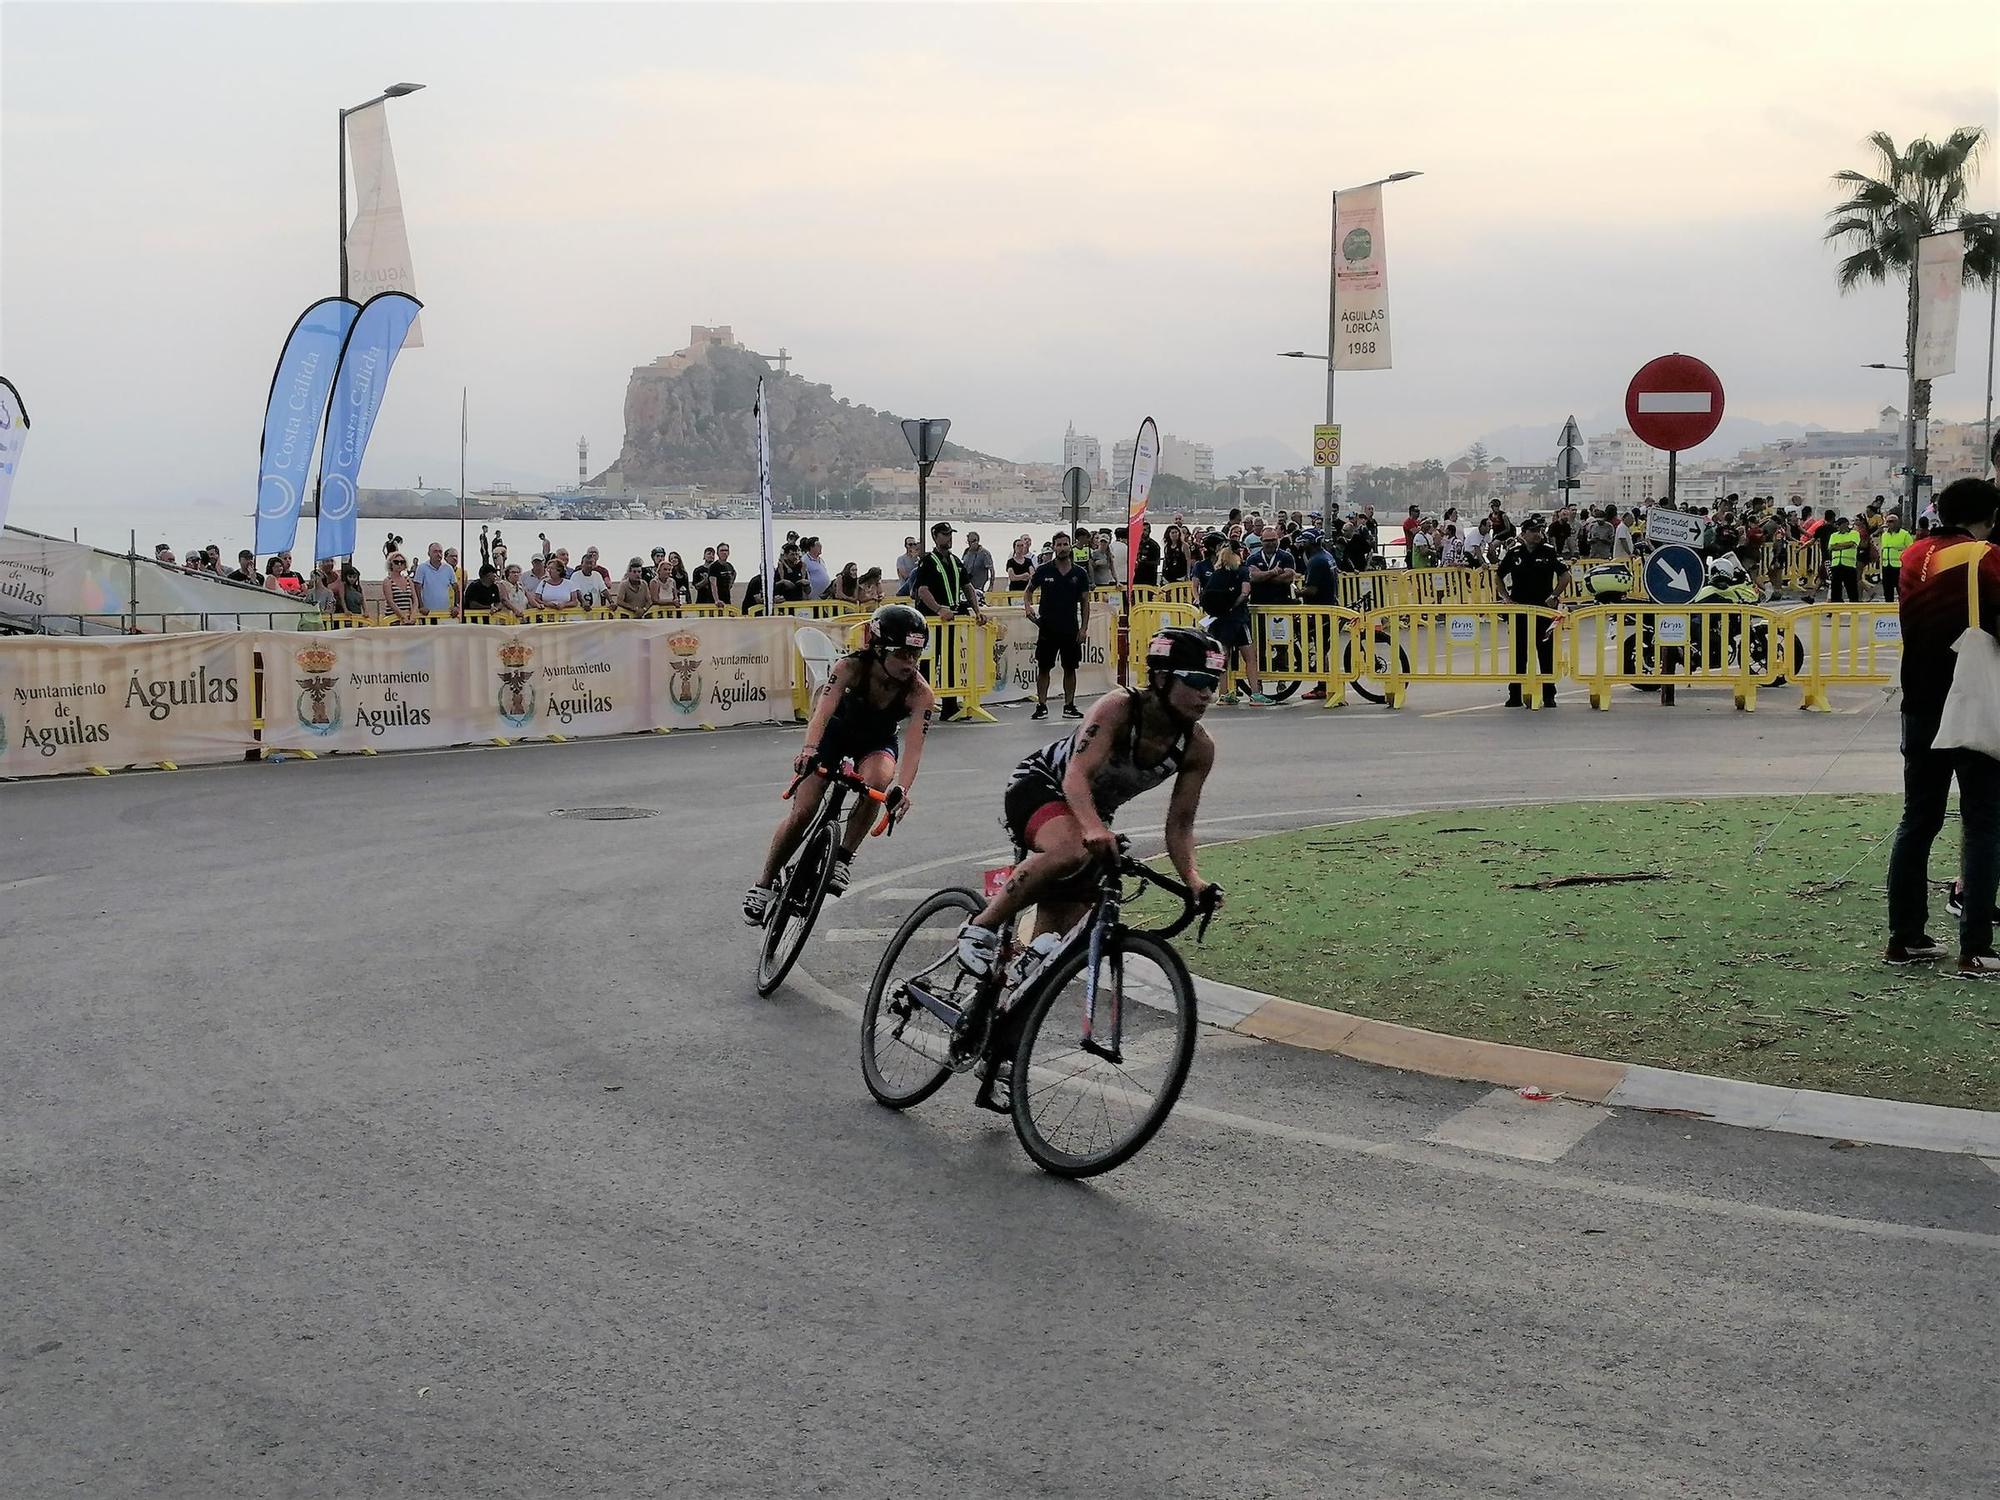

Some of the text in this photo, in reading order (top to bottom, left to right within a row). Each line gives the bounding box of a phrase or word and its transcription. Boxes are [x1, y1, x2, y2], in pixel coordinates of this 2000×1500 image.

[1346, 322, 1380, 334] LORCA
[1348, 341, 1376, 354] 1988
[275, 352, 320, 468] Costa Cálida
[338, 413, 359, 467] Costa
[9, 570, 22, 580] de
[0, 582, 45, 606] uilas
[542, 661, 611, 678] Ayuntamiento
[710, 653, 769, 667] Ayuntamiento
[350, 671, 429, 690] Ayuntamiento
[734, 668, 745, 681] de
[14, 681, 106, 705] Ayuntamiento
[125, 666, 239, 721] Águilas
[572, 678, 585, 691] de
[384, 687, 399, 702] de
[710, 680, 766, 711] Águilas
[54, 701, 70, 718] de
[546, 690, 613, 724] Águilas
[355, 701, 431, 736] Águilas
[22, 716, 110, 757] Águilas
